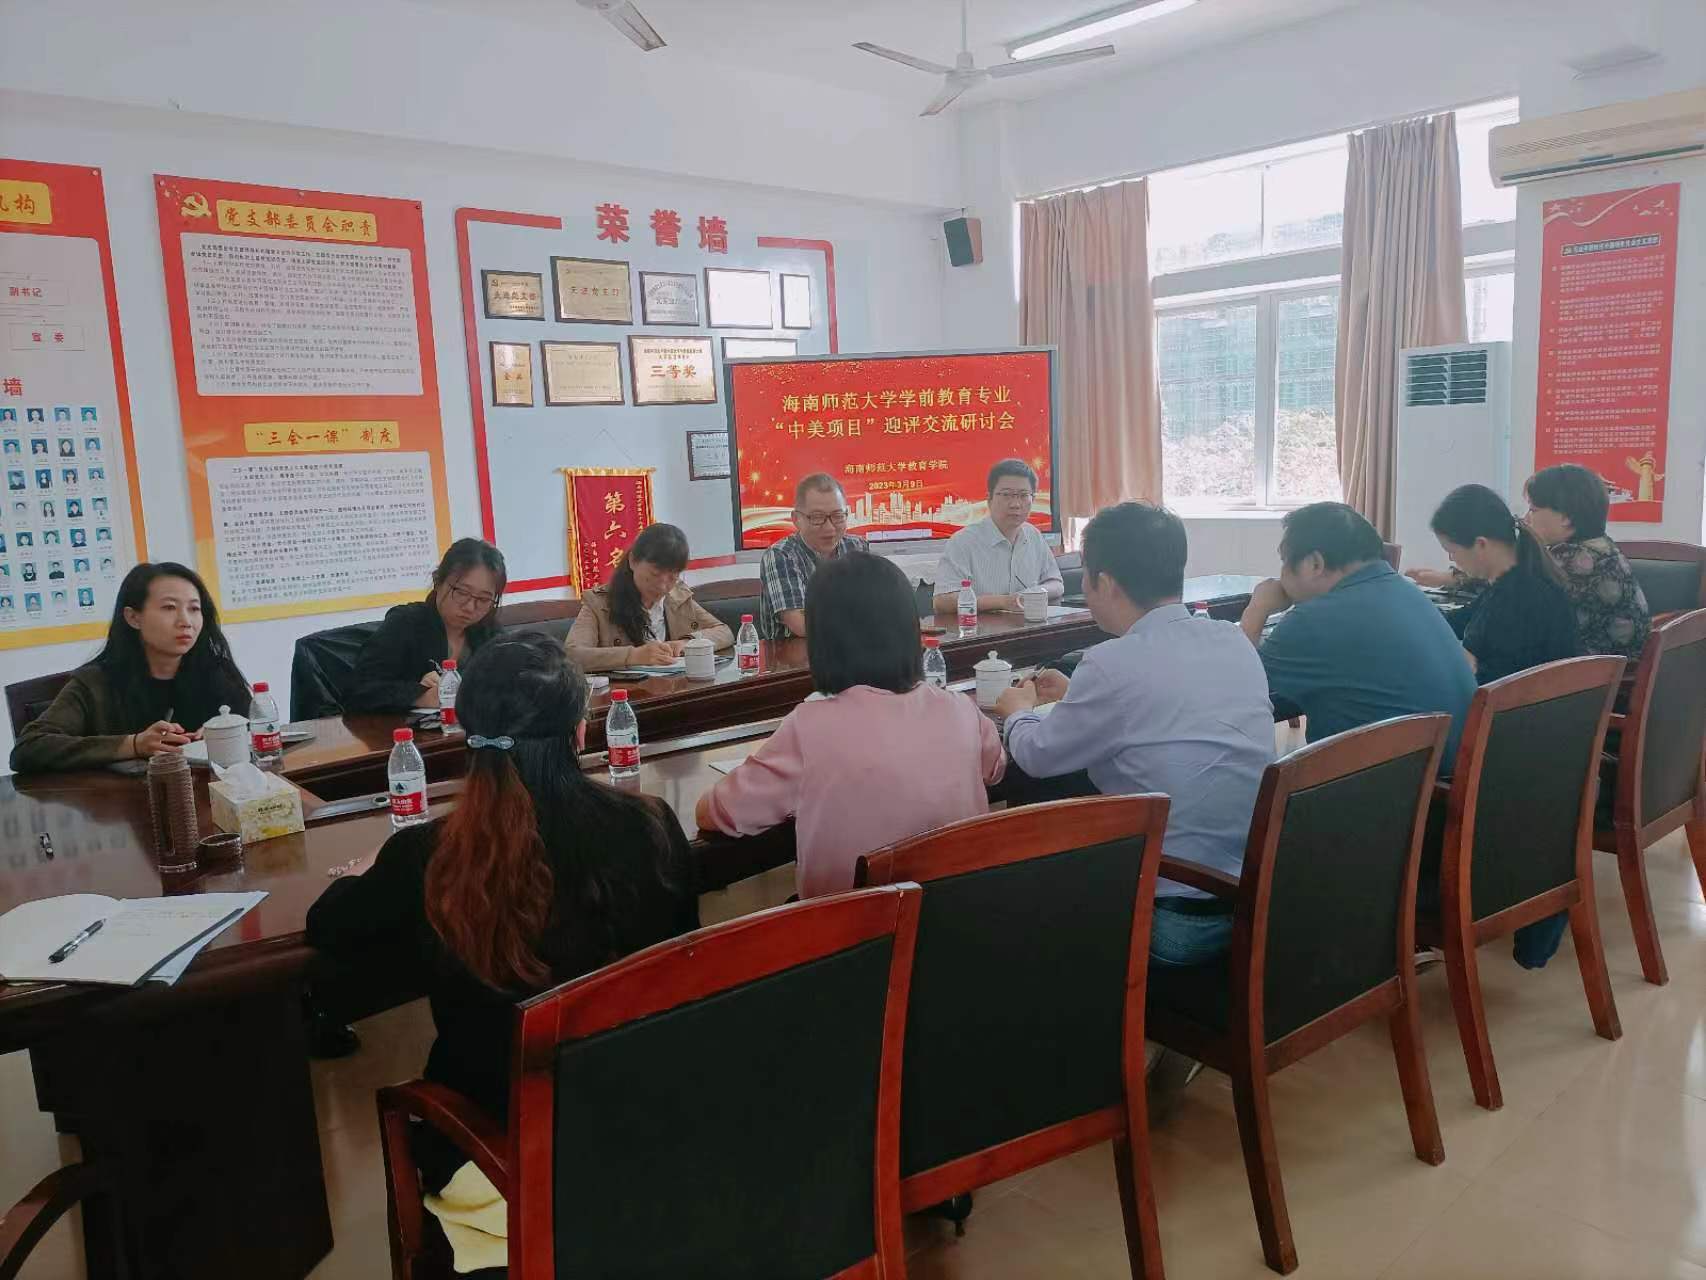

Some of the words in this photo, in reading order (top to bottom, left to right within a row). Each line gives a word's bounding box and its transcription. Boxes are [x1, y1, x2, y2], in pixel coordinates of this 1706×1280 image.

[224, 207, 372, 237] 党支部委员会职责
[596, 203, 729, 254] 荣誉墙
[8, 286, 43, 298] 副书记
[651, 364, 697, 379] 三等奖
[3, 377, 23, 397] 墙
[782, 385, 1011, 413] 海南师范大学学前教育专业
[844, 460, 949, 474] 海南师范大学教育学院
